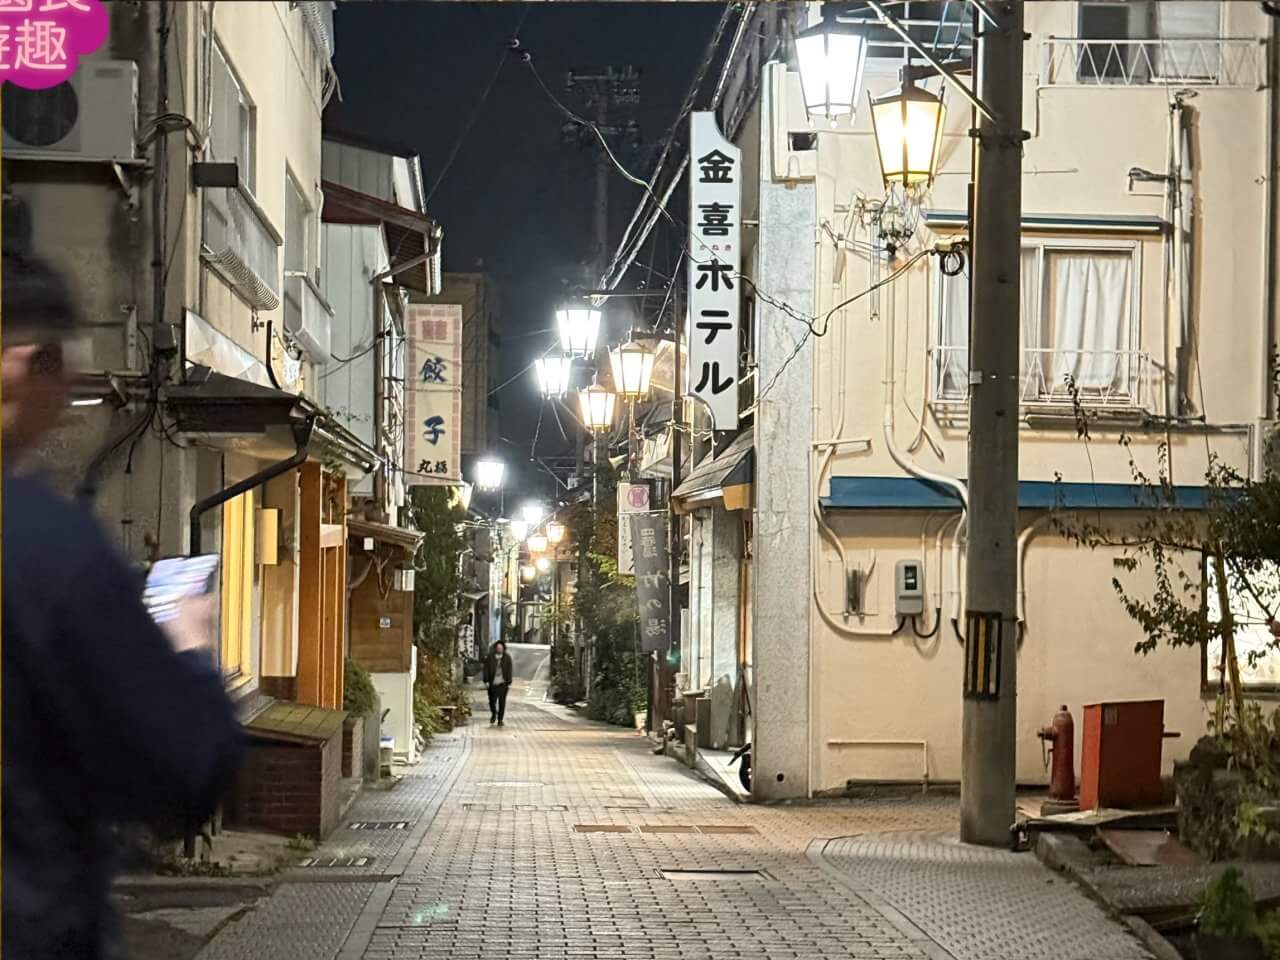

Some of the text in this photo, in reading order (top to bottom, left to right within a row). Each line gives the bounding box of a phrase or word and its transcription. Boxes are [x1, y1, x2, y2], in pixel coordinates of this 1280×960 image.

[695, 149, 735, 395] 金喜ホテル
[420, 356, 448, 447] 餃子
